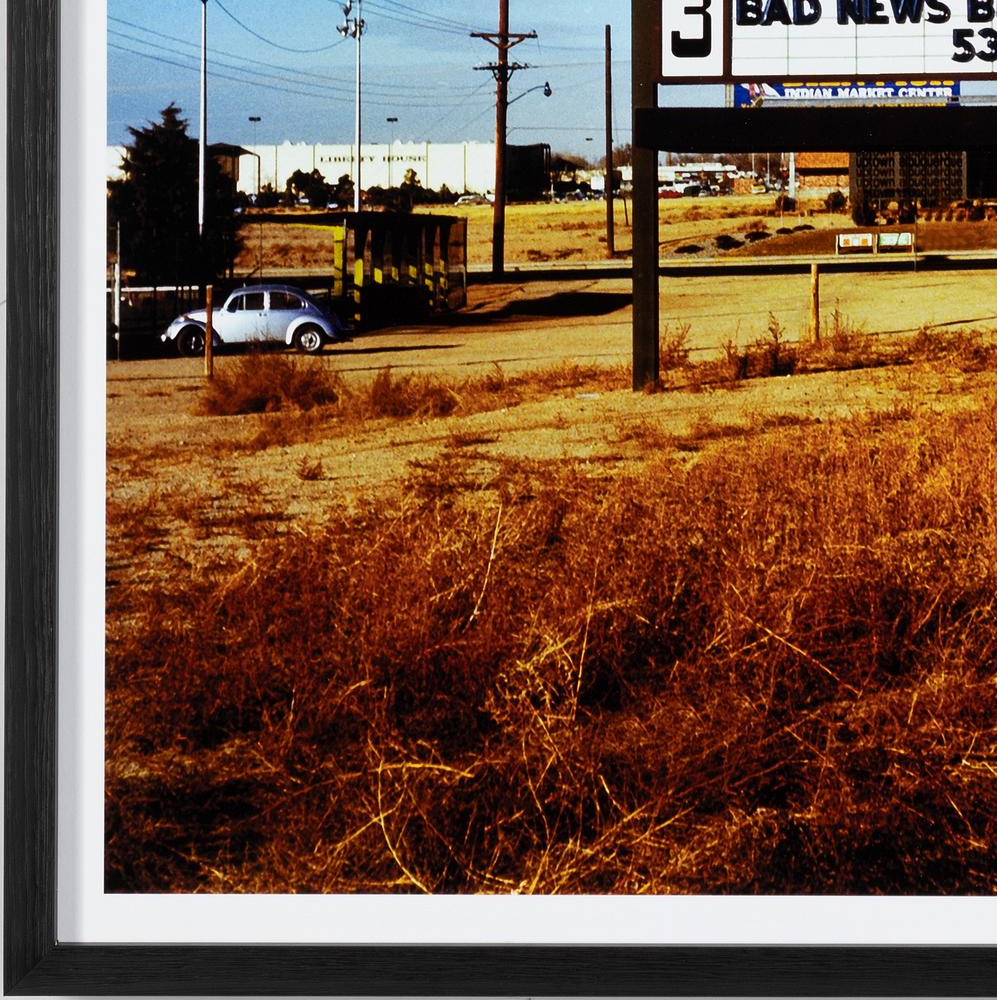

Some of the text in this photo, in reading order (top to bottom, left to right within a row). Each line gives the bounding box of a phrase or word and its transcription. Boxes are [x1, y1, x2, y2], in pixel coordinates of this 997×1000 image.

[784, 86, 953, 99] INDIAN MARKET CENTER
